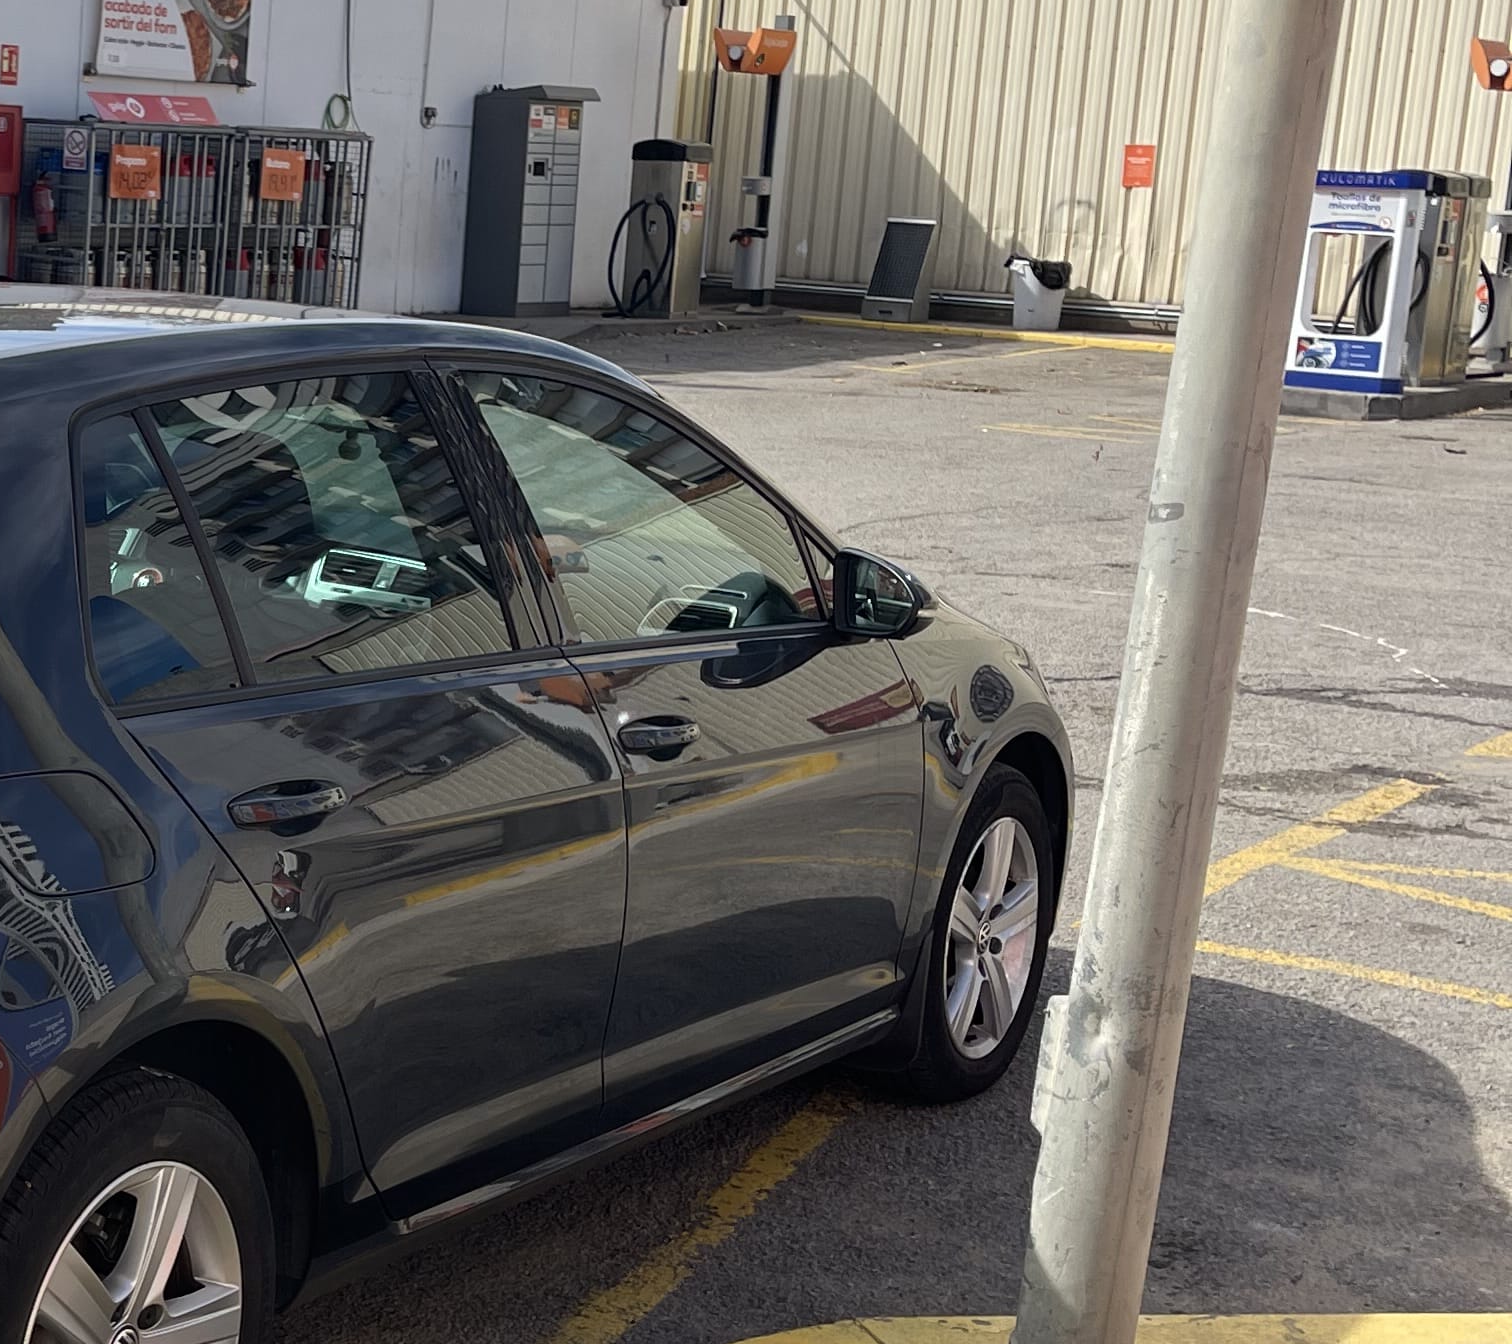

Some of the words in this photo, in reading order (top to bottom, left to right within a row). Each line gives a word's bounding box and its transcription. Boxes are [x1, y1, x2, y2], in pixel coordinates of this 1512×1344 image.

[104, 0, 152, 16] acabada
[154, 4, 168, 18] de
[104, 16, 134, 30] sortir
[136, 18, 153, 32] del
[154, 19, 177, 35] forn
